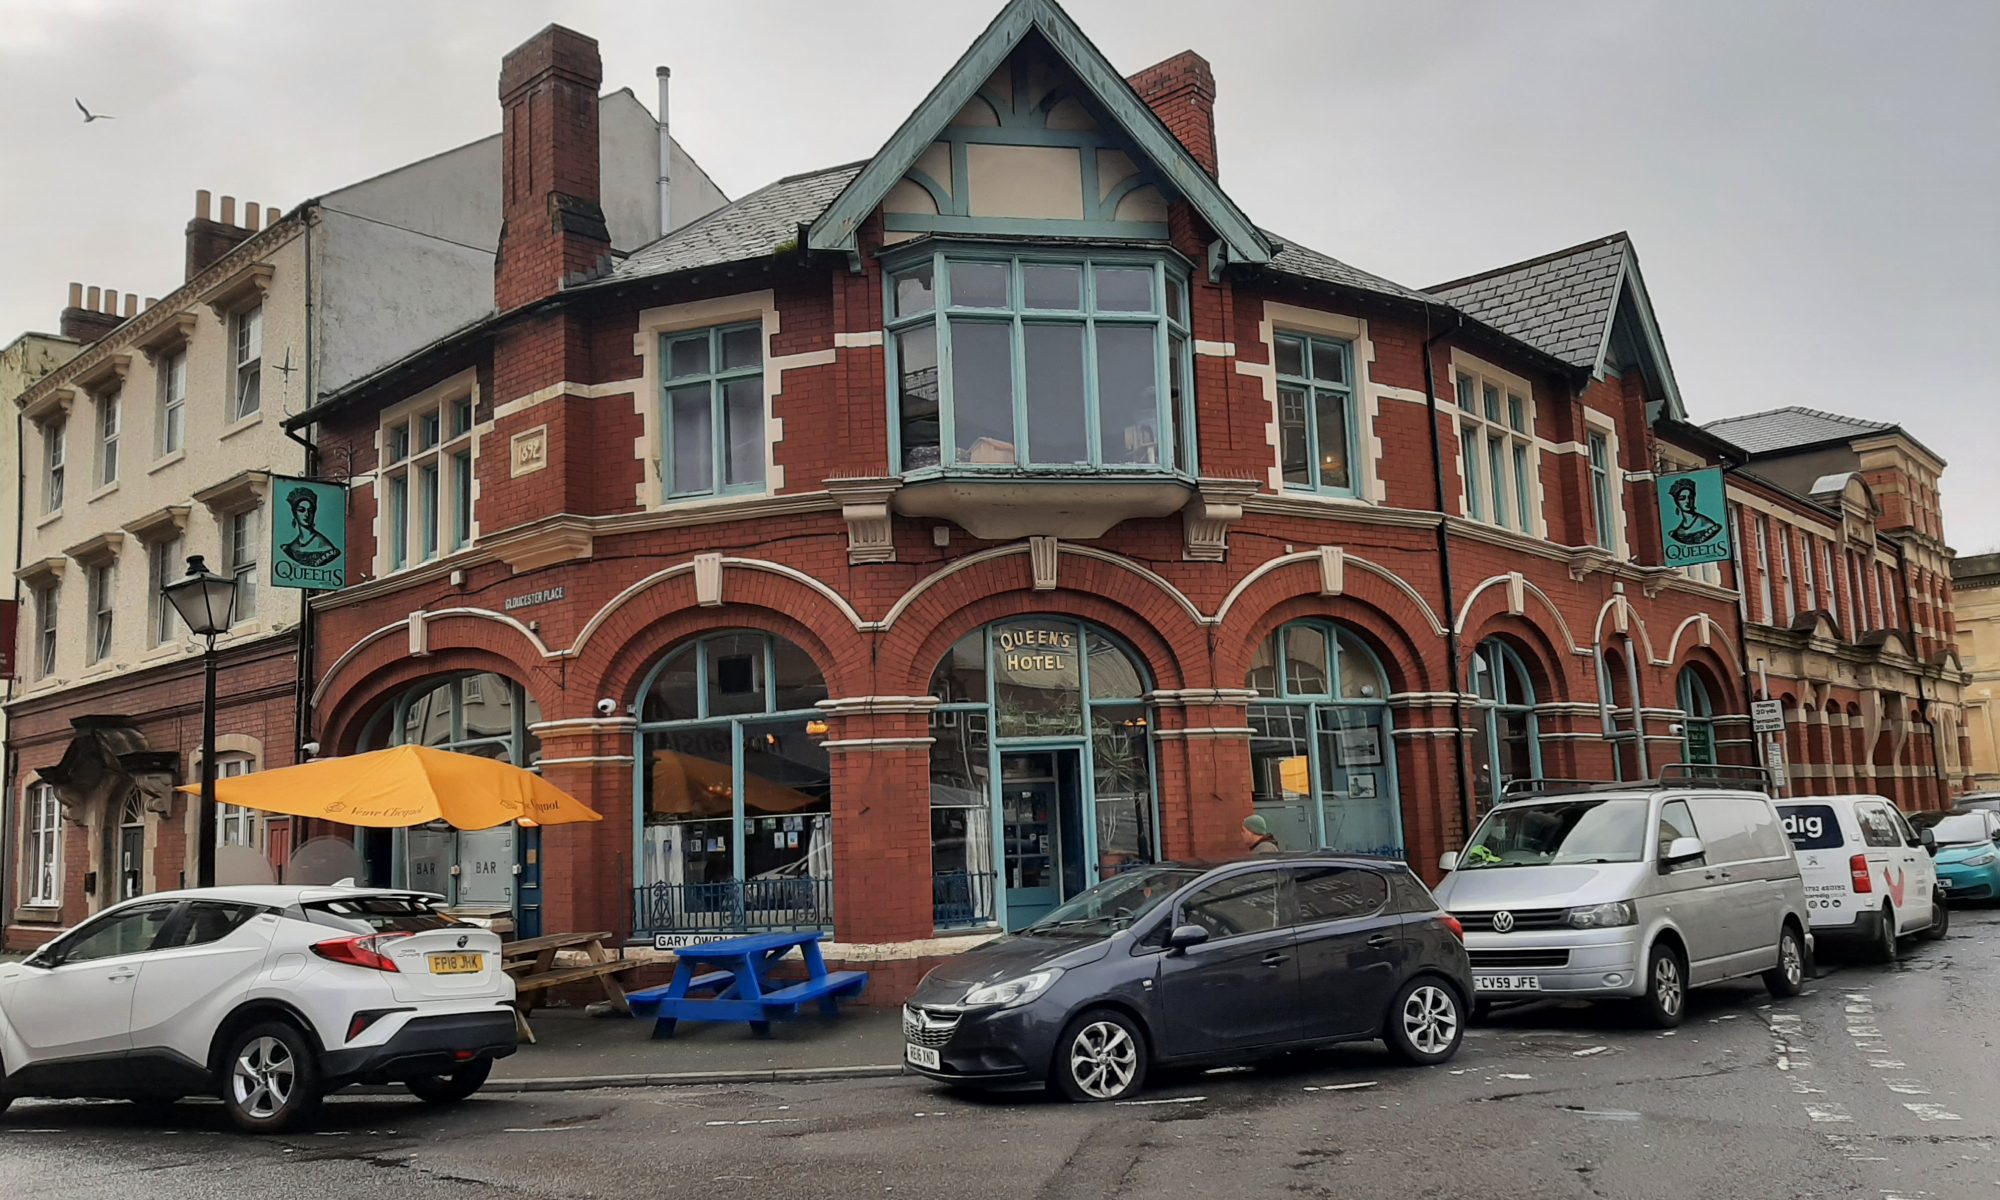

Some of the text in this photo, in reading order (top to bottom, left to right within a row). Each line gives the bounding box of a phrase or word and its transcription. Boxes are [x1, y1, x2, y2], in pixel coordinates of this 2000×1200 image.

[505, 587, 563, 610] GLOUCESTER PLACE
[1000, 630, 1070, 652] QUEEN'S
[1007, 654, 1064, 670] HOTEL
[416, 863, 436, 875] BAR
[476, 861, 497, 875] BAR
[658, 936, 688, 946] GARY
[434, 955, 478, 970] FP18 JHK
[1481, 976, 1537, 988] CV59 JFE
